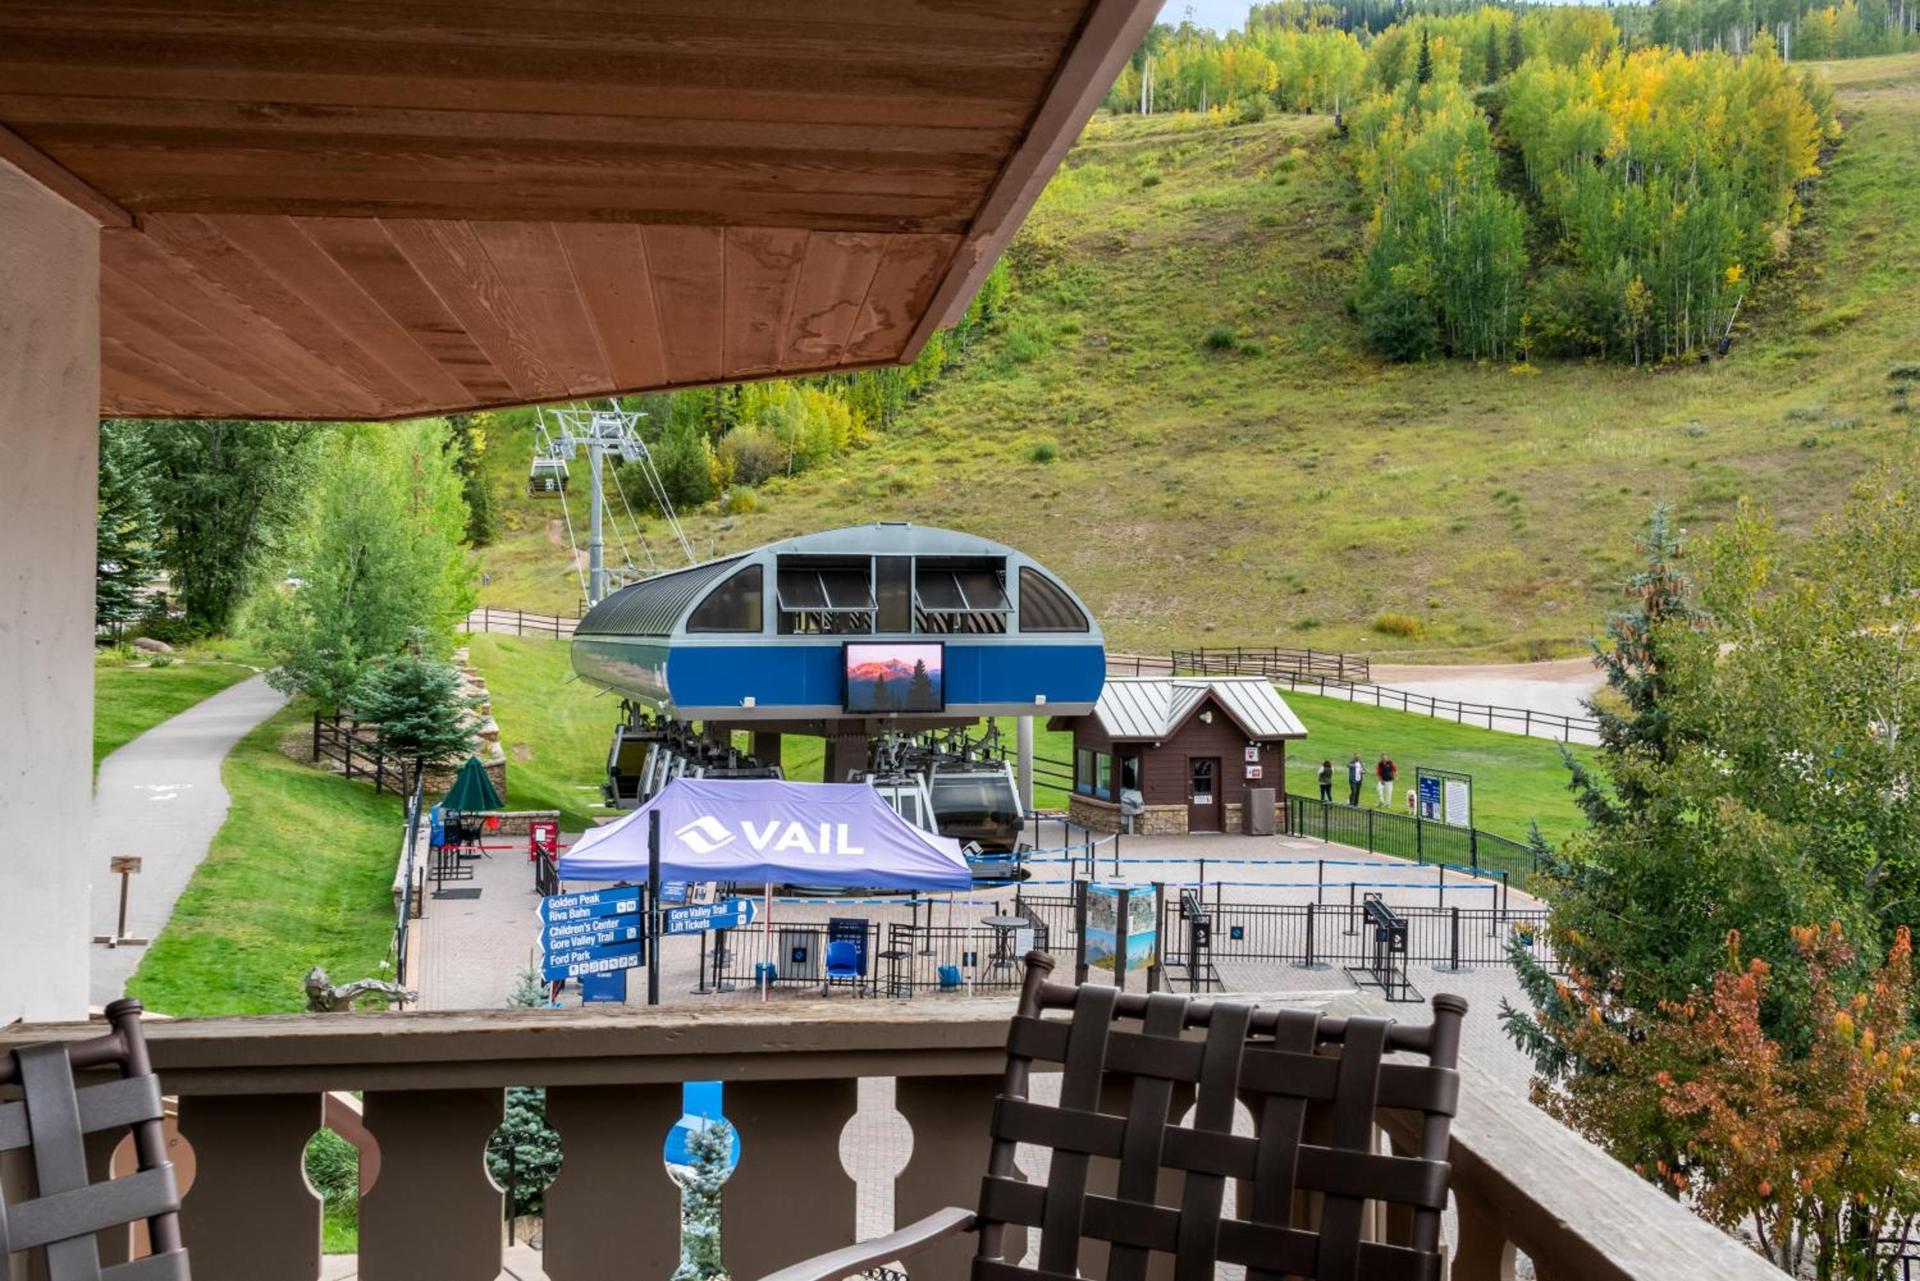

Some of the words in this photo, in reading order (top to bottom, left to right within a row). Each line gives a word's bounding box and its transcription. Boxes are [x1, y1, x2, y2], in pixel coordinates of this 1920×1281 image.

[740, 820, 865, 855] VAIL
[549, 897, 577, 909] Golden
[579, 893, 600, 904] Peak
[549, 910, 568, 922] Riva
[569, 907, 591, 919] Bahn
[671, 909, 688, 920] Gore
[689, 907, 711, 919] Valley
[712, 904, 727, 914] Trail
[549, 922, 591, 937] Children's
[592, 919, 619, 931] Center
[671, 921, 684, 932] Lift
[685, 918, 710, 930] Tickets
[550, 939, 570, 950] Gore
[571, 935, 596, 948] Valley
[598, 931, 614, 943] Trail
[550, 953, 569, 966] Ford
[571, 950, 591, 961] Park
